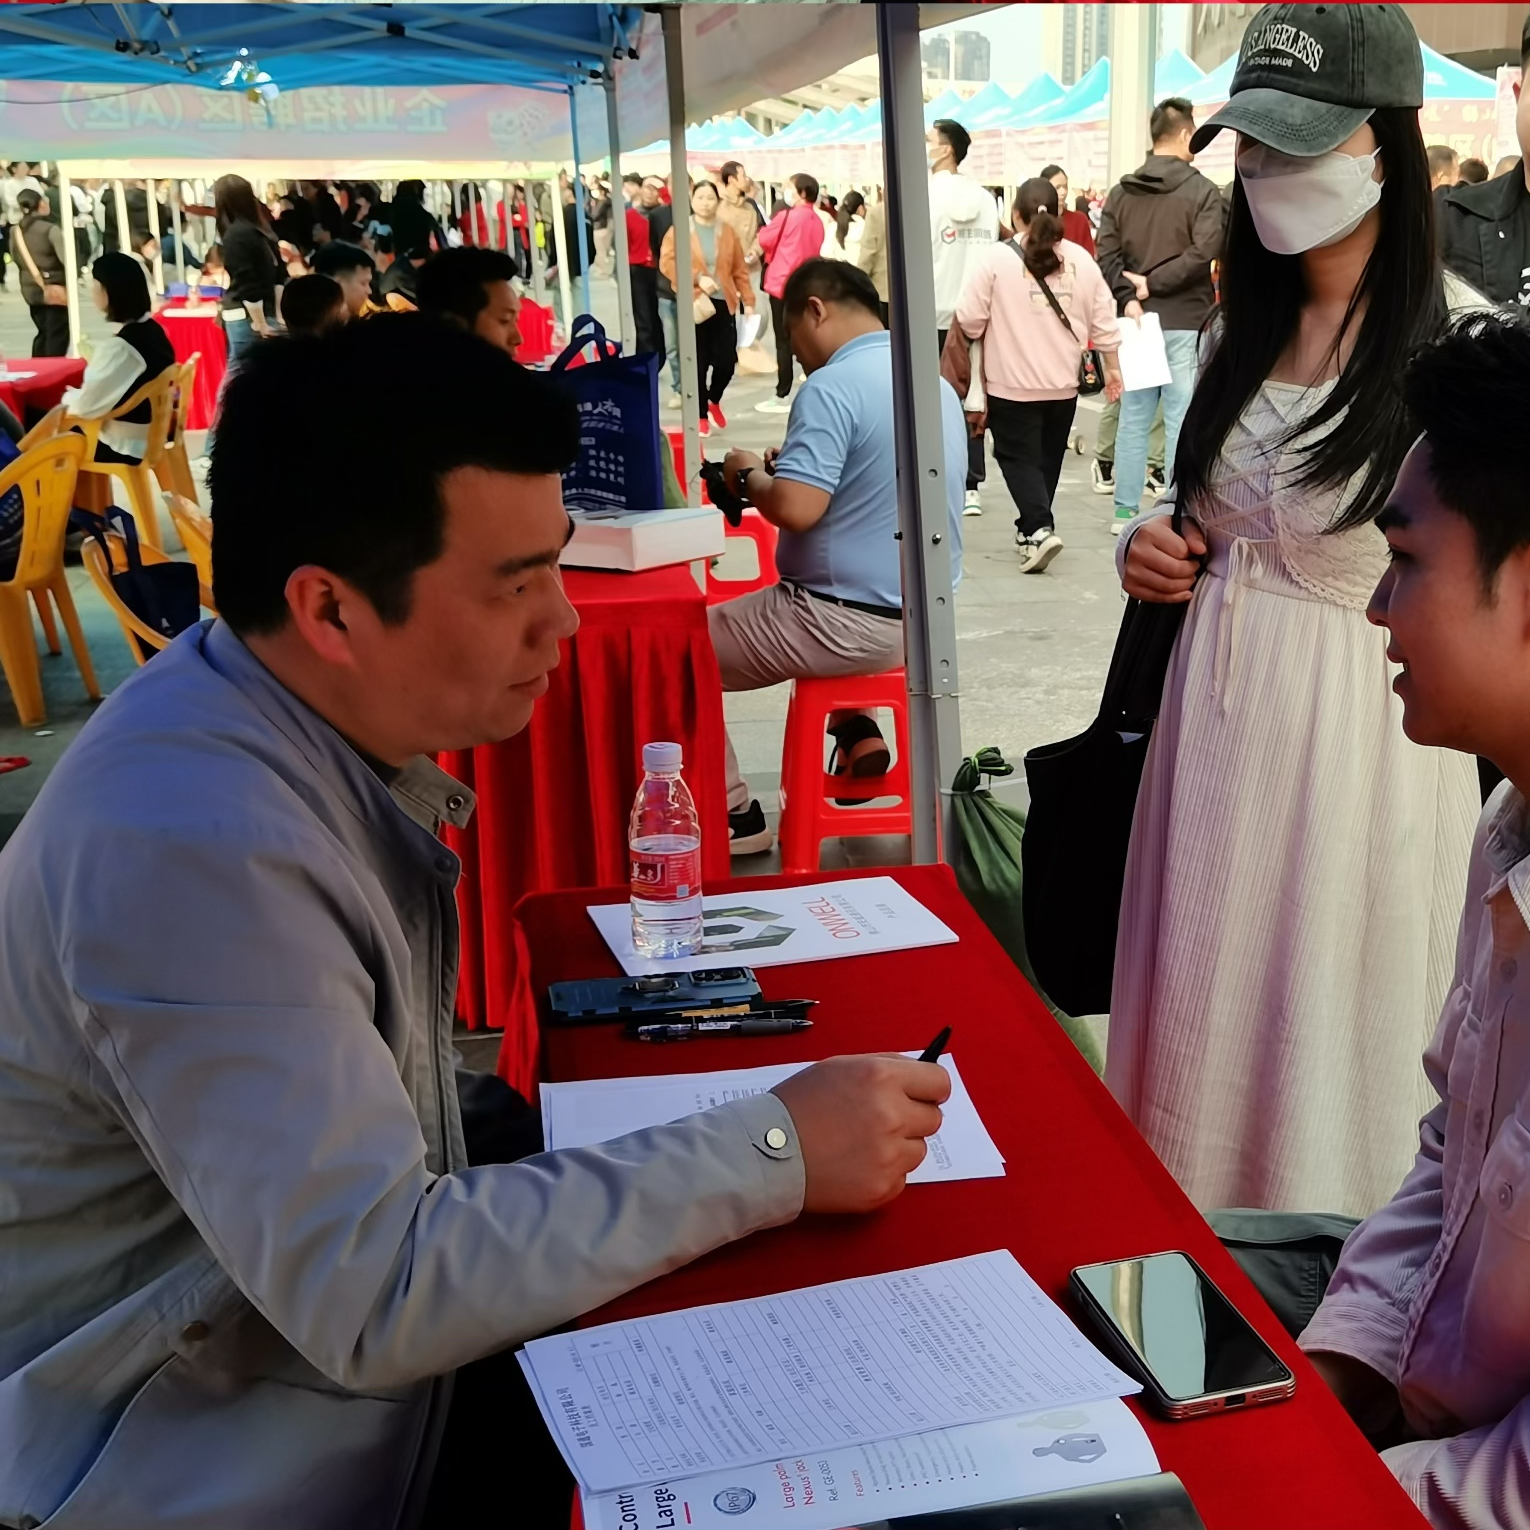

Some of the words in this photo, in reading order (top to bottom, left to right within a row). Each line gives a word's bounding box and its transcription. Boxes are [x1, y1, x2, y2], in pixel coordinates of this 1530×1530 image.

[802, 896, 861, 940] ONWELL
[726, 1490, 741, 1511] IP67
[781, 1481, 796, 1509] Large
